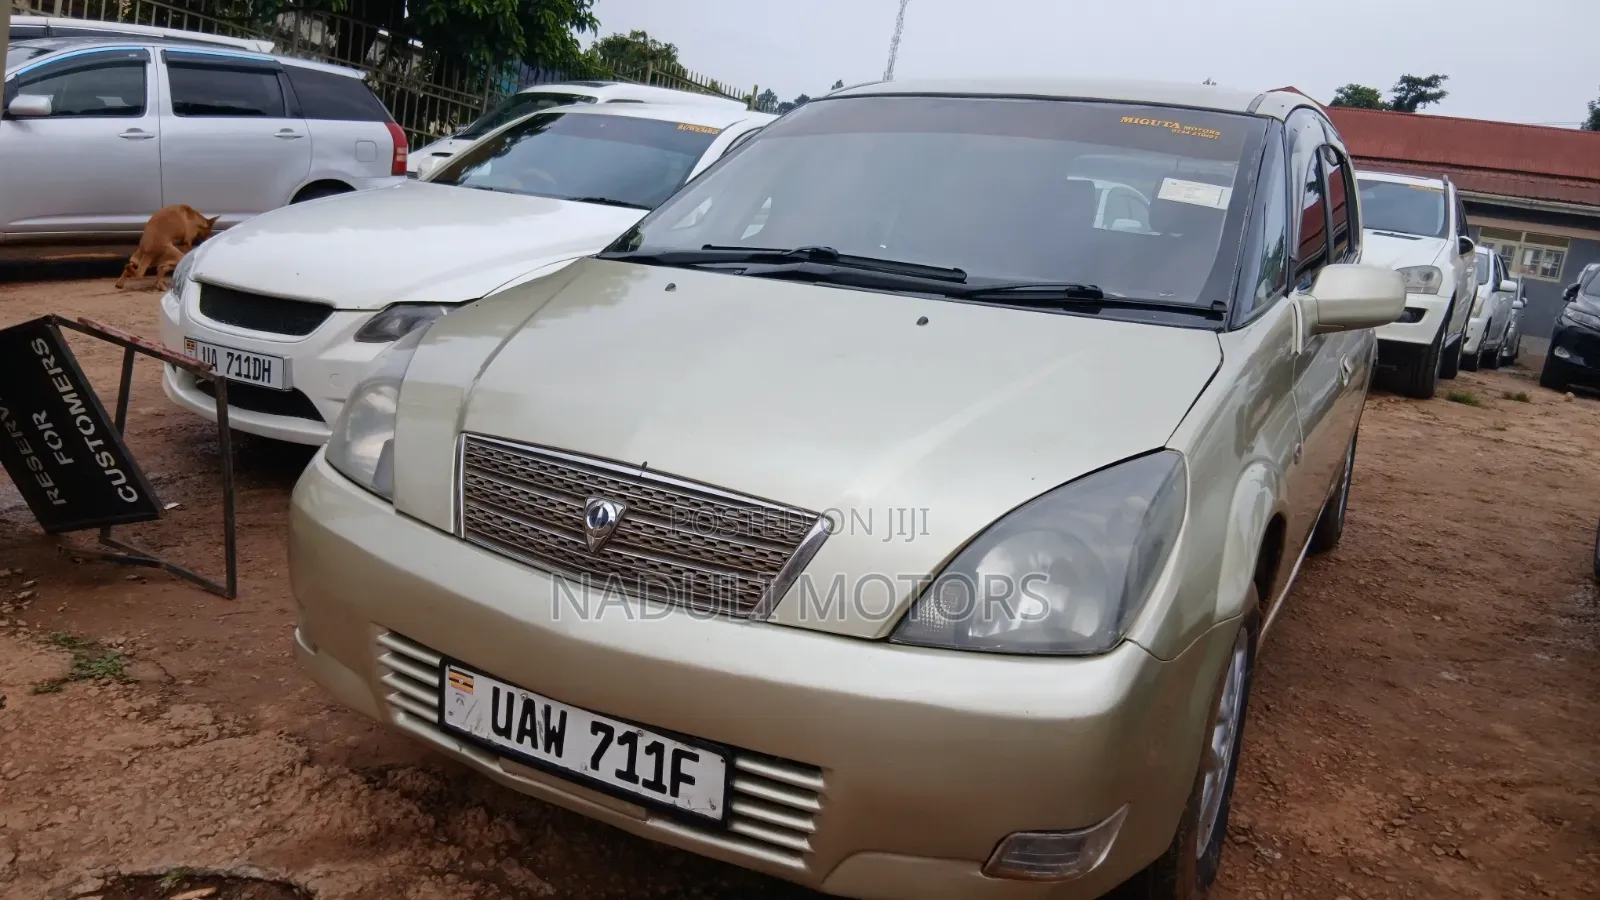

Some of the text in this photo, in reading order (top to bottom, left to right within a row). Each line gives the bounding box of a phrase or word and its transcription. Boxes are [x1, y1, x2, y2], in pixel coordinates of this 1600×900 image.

[1120, 116, 1220, 136] MIGUTA MOTORS
[226, 351, 272, 383] 711DH
[0, 396, 67, 505] RESERV
[31, 337, 139, 504] CUSTOMERS
[32, 409, 75, 466] FOR
[491, 685, 700, 799] UAW 711F
